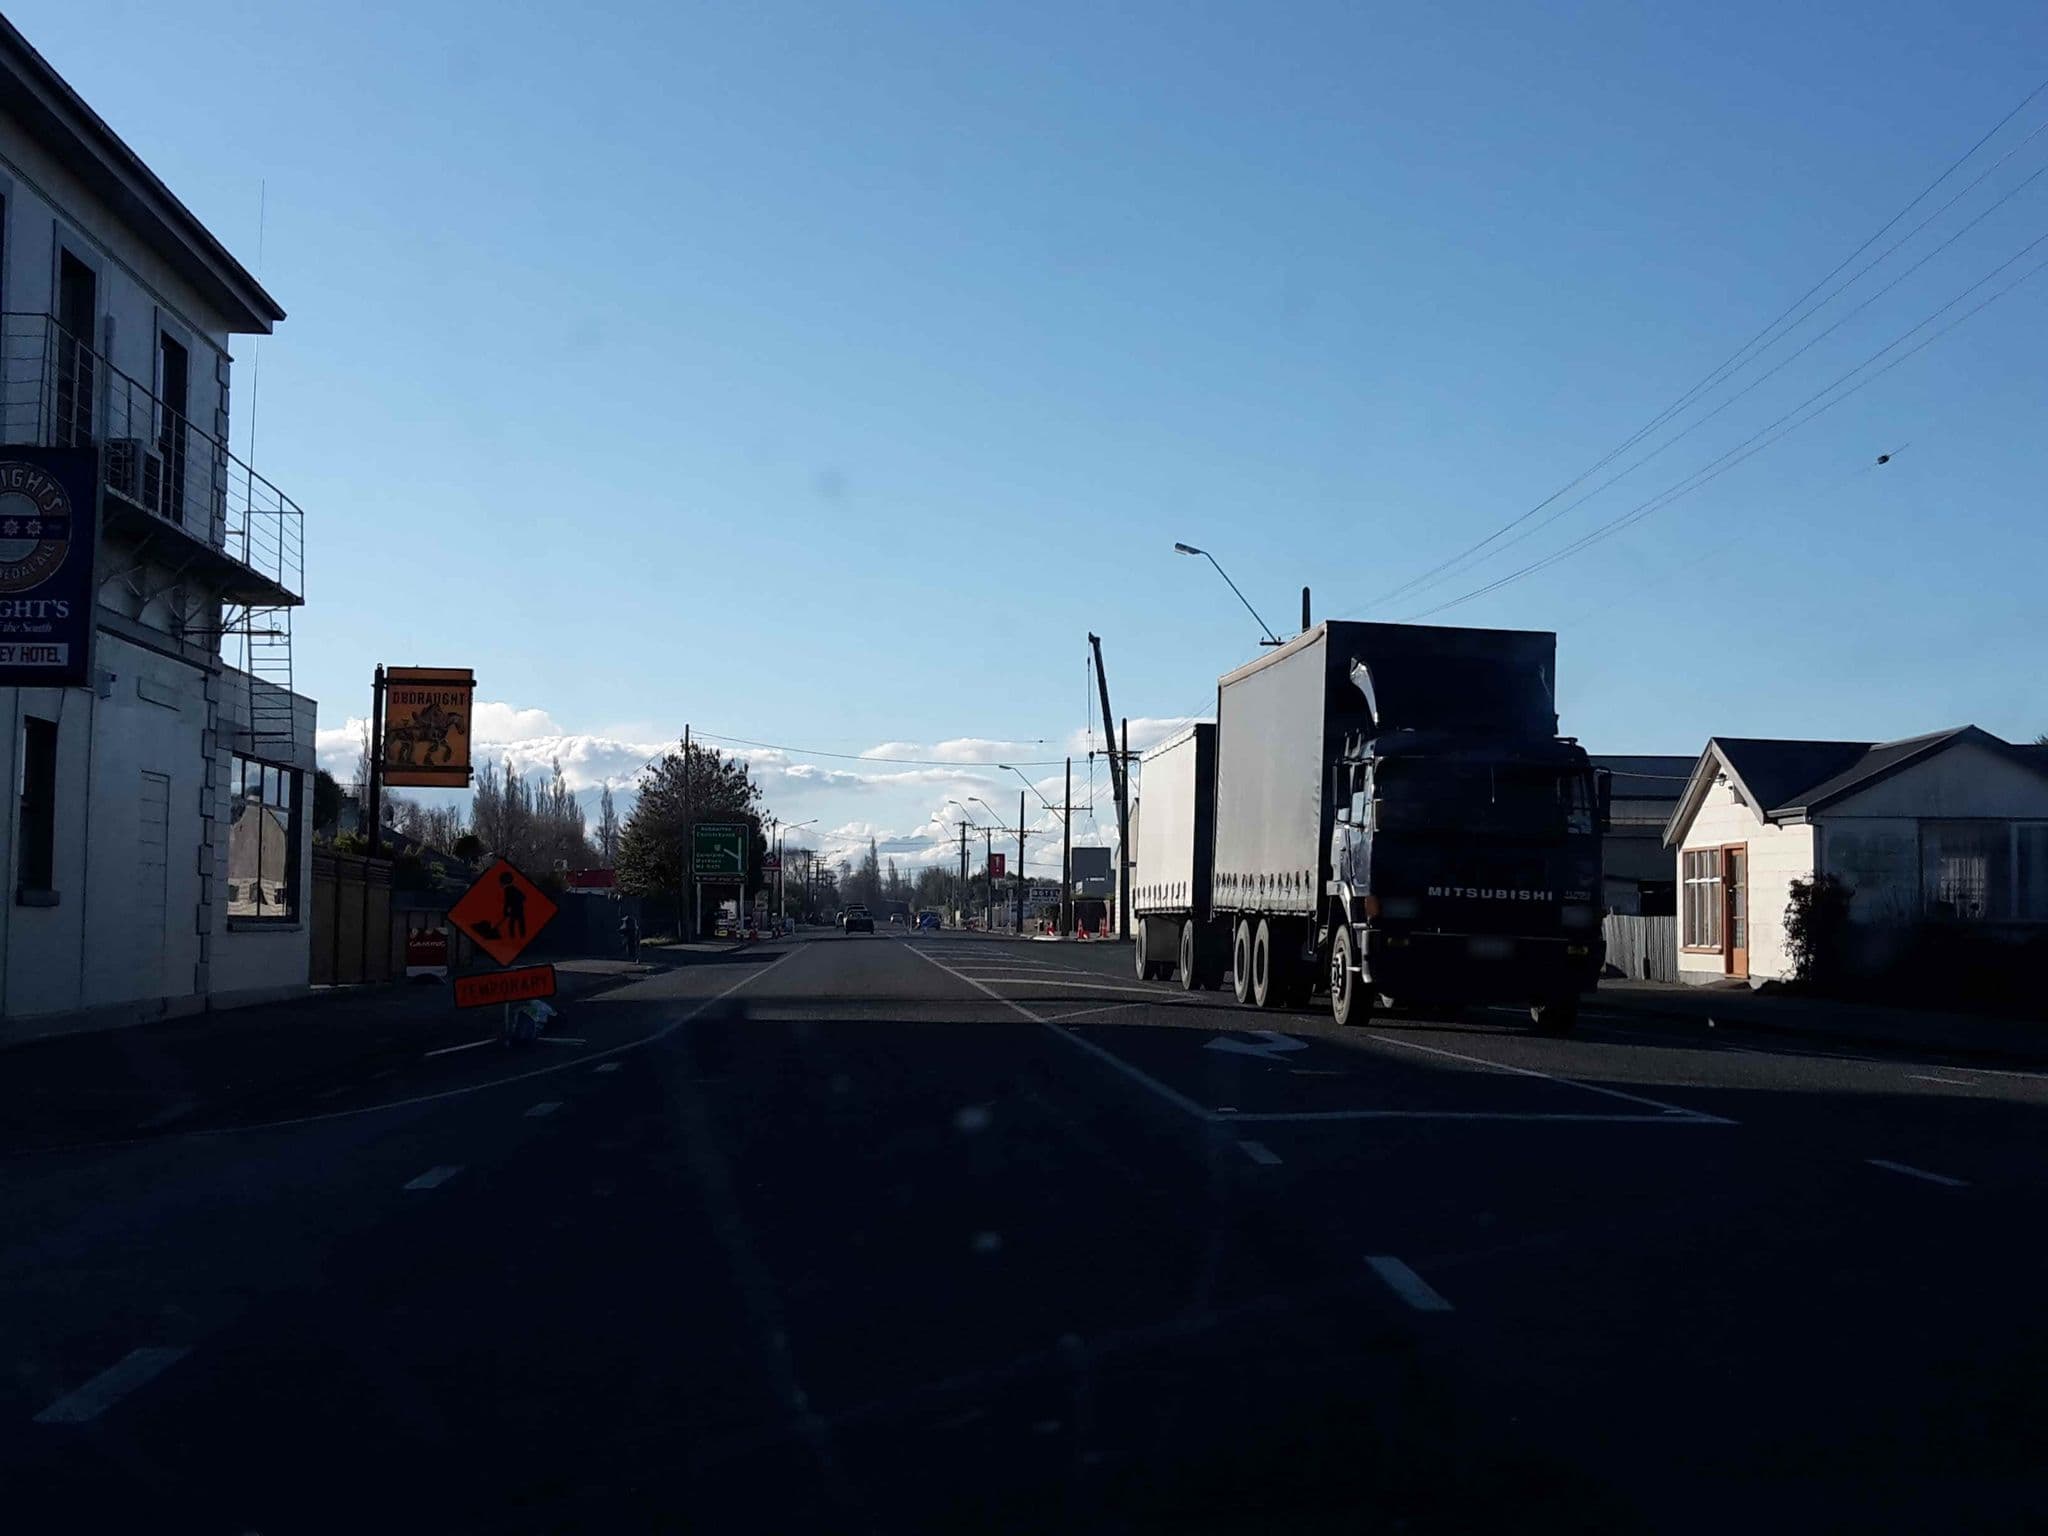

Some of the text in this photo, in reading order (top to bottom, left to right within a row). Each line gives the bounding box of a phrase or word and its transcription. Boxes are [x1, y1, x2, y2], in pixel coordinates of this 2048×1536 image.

[20, 646, 61, 663] HOTEL
[1427, 886, 1553, 901] MITSUBISHI
[459, 974, 547, 1002] TEMPORARY
